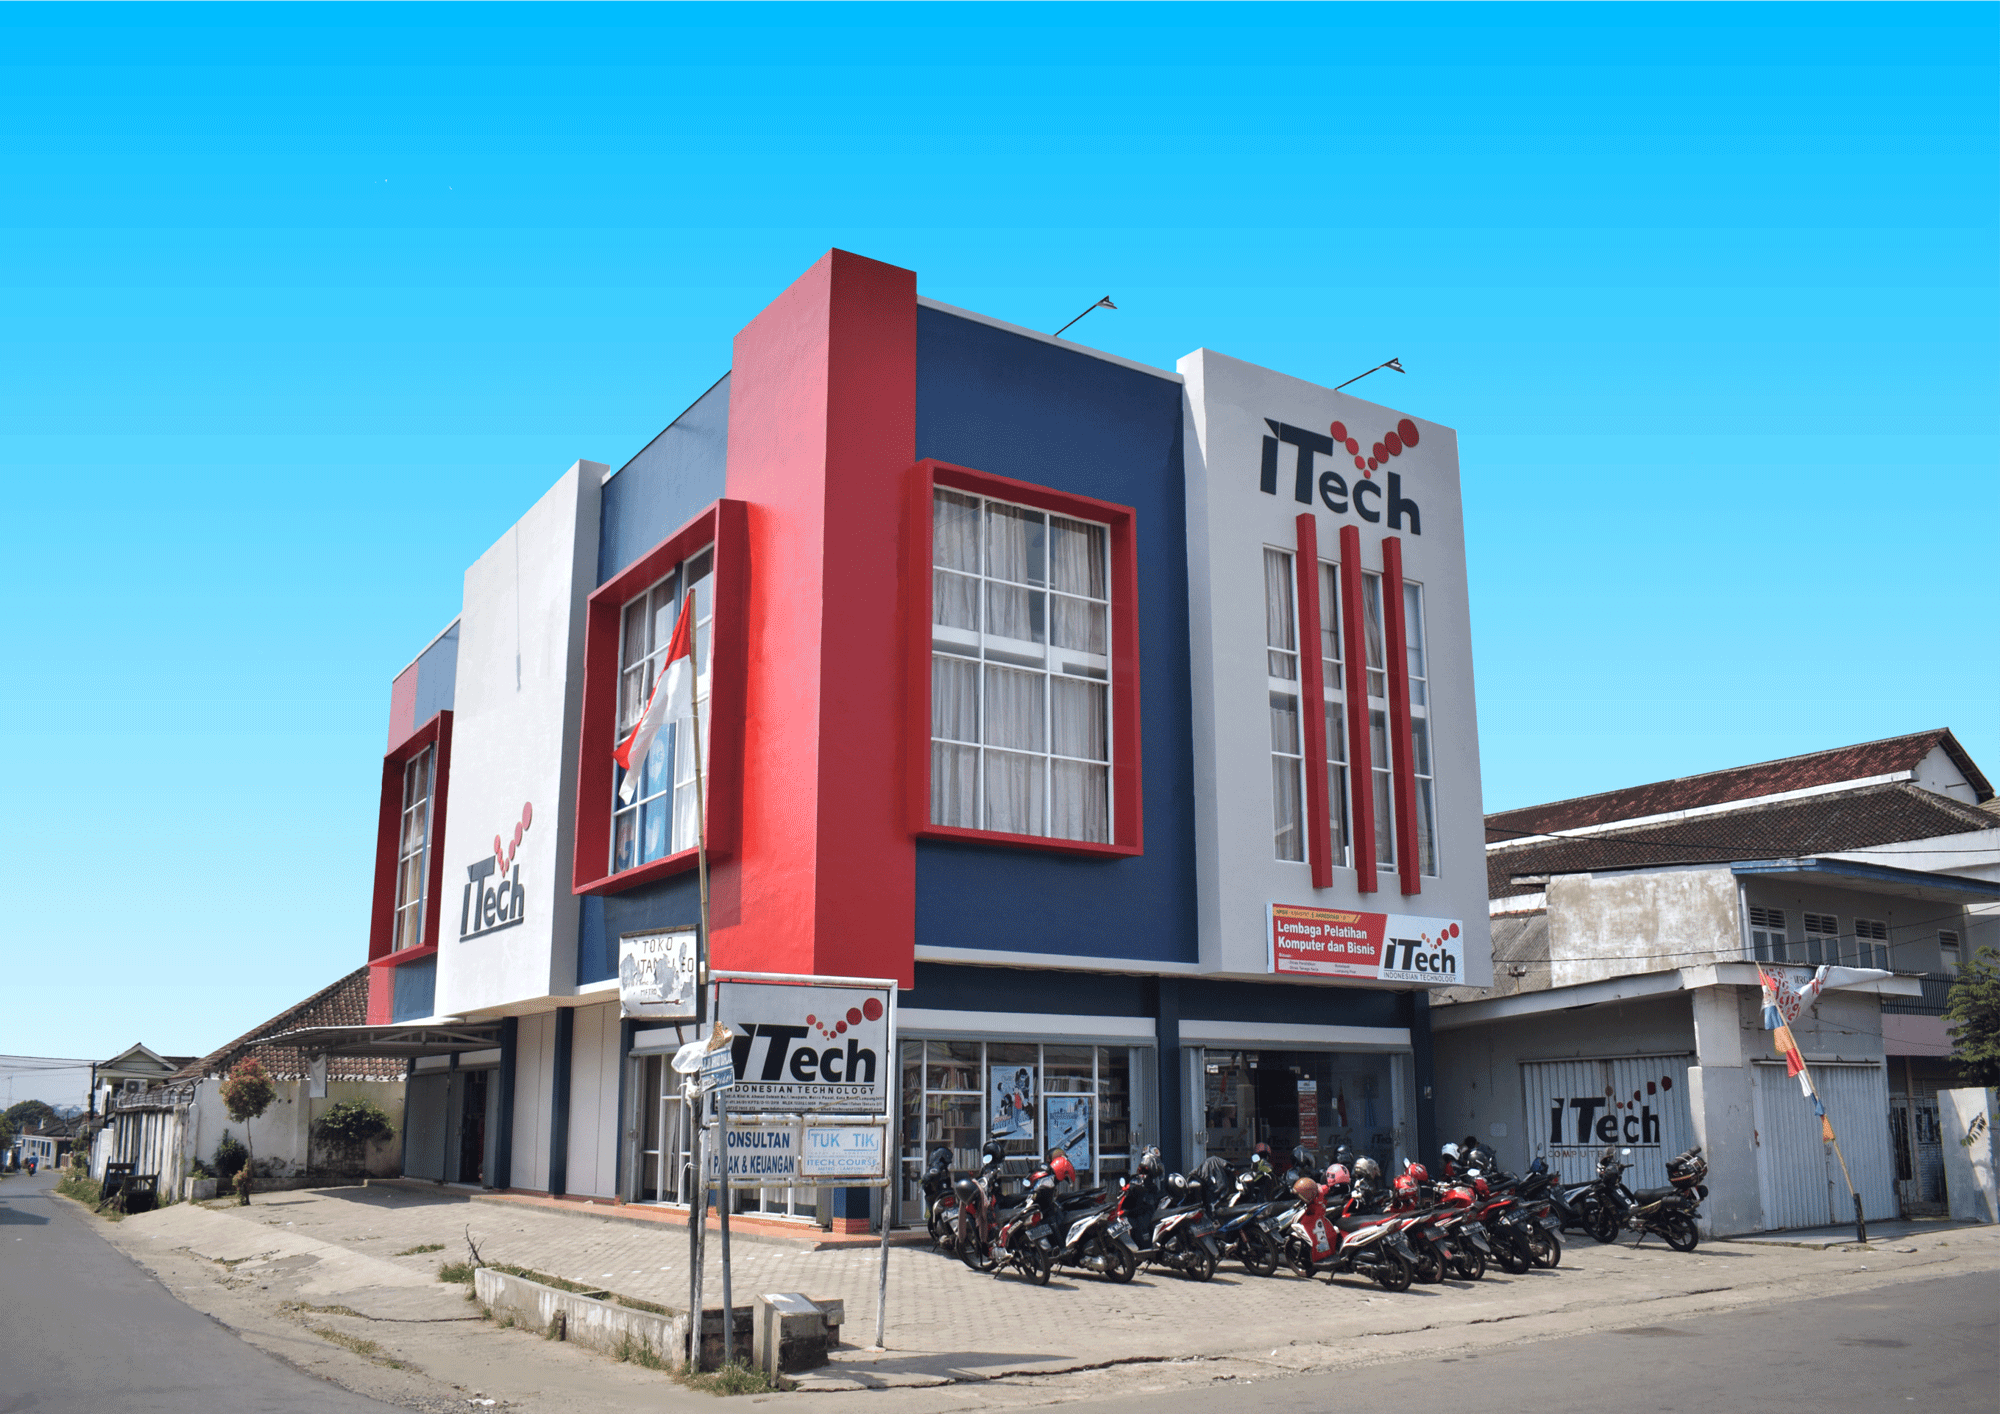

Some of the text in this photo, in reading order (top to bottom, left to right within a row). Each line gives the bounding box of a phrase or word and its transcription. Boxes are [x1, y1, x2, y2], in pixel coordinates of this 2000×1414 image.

[1260, 417, 1421, 536] iTech
[460, 854, 525, 936] iTech
[1277, 920, 1367, 939] Lembaga Pelatihan
[643, 936, 673, 954] TOKO
[1278, 936, 1375, 955] Komputer dan Bisnis
[1384, 938, 1456, 973] iTech
[1384, 972, 1456, 982] INDONESIAN TECHNOLOGY
[732, 1023, 876, 1082] iTech
[726, 1085, 875, 1094] NDONESIAN TECHNOLOGY
[1550, 1098, 1660, 1143] iTech
[727, 1131, 790, 1148] ONSULTAN
[811, 1133, 875, 1147] TUK TIK
[714, 1155, 794, 1174] PAK & KEUANGAN
